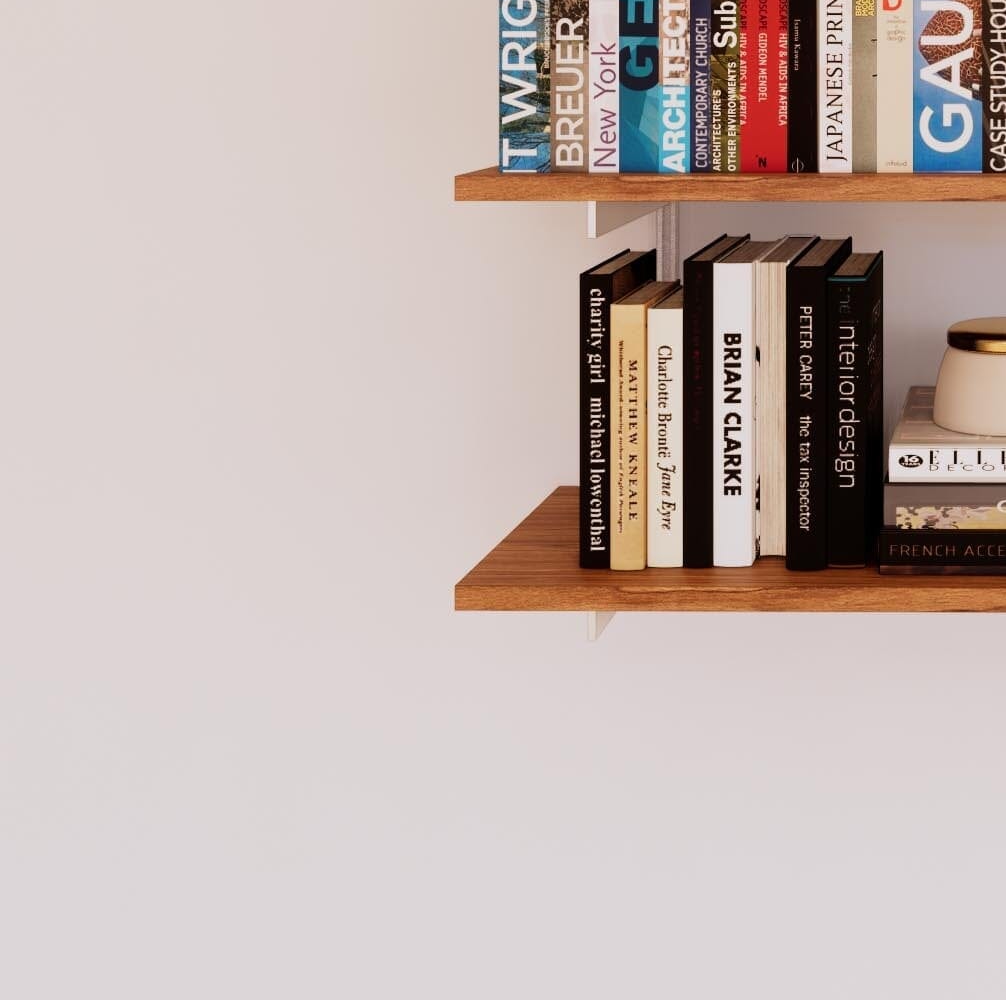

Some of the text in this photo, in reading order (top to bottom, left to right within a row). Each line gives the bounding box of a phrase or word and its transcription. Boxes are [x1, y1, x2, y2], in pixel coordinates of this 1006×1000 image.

[695, 17, 708, 66] CHURCH
[758, 32, 767, 66] GIDEON
[758, 68, 767, 102] MENDEL
[779, 33, 787, 49] HIV
[779, 60, 787, 80] AIDS
[555, 17, 584, 167] BREUER
[591, 42, 617, 167] New York
[695, 71, 708, 168] CONTEMPORARY
[712, 89, 722, 171] ARCHITECTURE'S
[727, 61, 737, 171] OTHER ENVIRONMENTS
[779, 82, 787, 93] IN
[779, 95, 787, 126] AFRICA
[826, 53, 847, 161] JAPANESE
[586, 288, 606, 551] charity girl michael lowenthal
[628, 360, 638, 521] MATTHEW KNEALE
[656, 345, 677, 530] Charlotte Brontë Jane Eyre
[723, 333, 742, 496] BRIAN CLARKE
[797, 306, 813, 531] PETER CAREY the tax inspector
[834, 408, 861, 488] design
[889, 545, 956, 557] FRENCH
